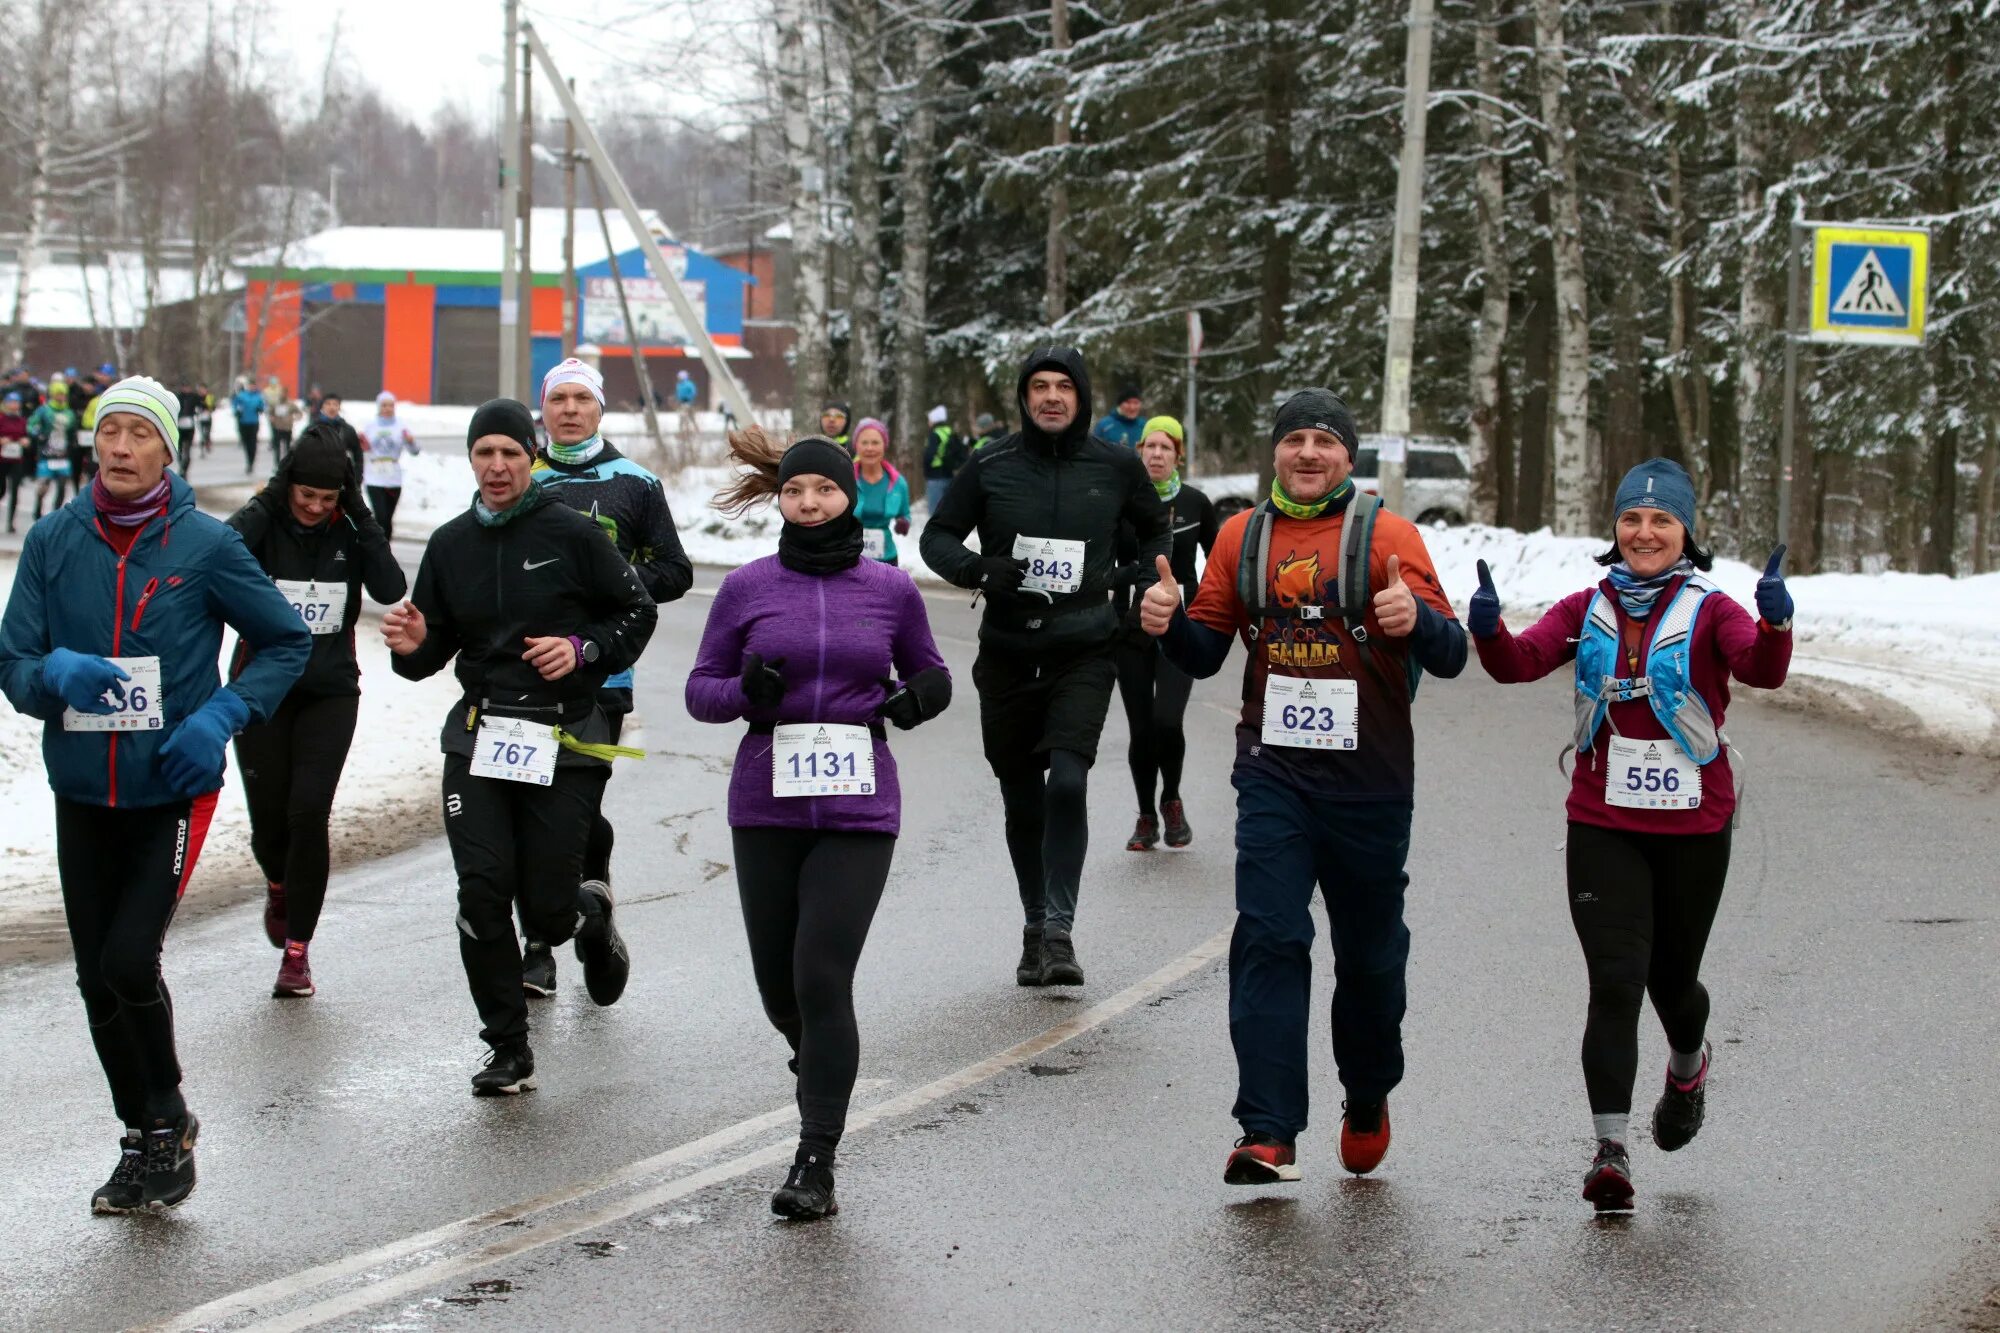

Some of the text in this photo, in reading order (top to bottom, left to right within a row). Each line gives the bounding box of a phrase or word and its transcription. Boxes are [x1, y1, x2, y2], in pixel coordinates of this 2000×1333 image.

[1023, 559, 1072, 580] 843
[1266, 643, 1339, 667] БАНДА
[1282, 704, 1334, 732] 623
[492, 741, 537, 766] 767
[788, 752, 855, 777] 1131
[1626, 766, 1680, 792] 556
[173, 818, 187, 876] noname
